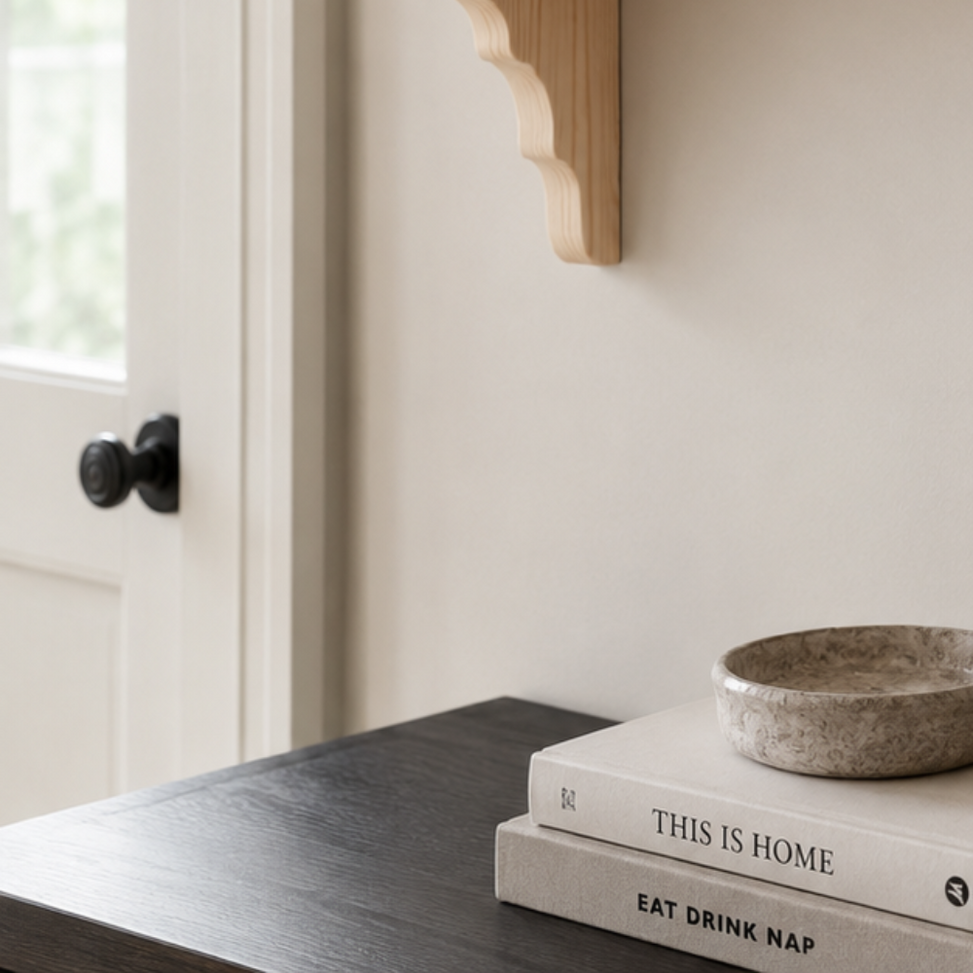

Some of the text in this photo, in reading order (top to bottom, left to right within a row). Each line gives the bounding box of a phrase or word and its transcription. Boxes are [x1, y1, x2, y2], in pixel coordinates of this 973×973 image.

[652, 808, 834, 875] THIS IS HOME
[638, 893, 815, 954] EAT DRINK NAP
